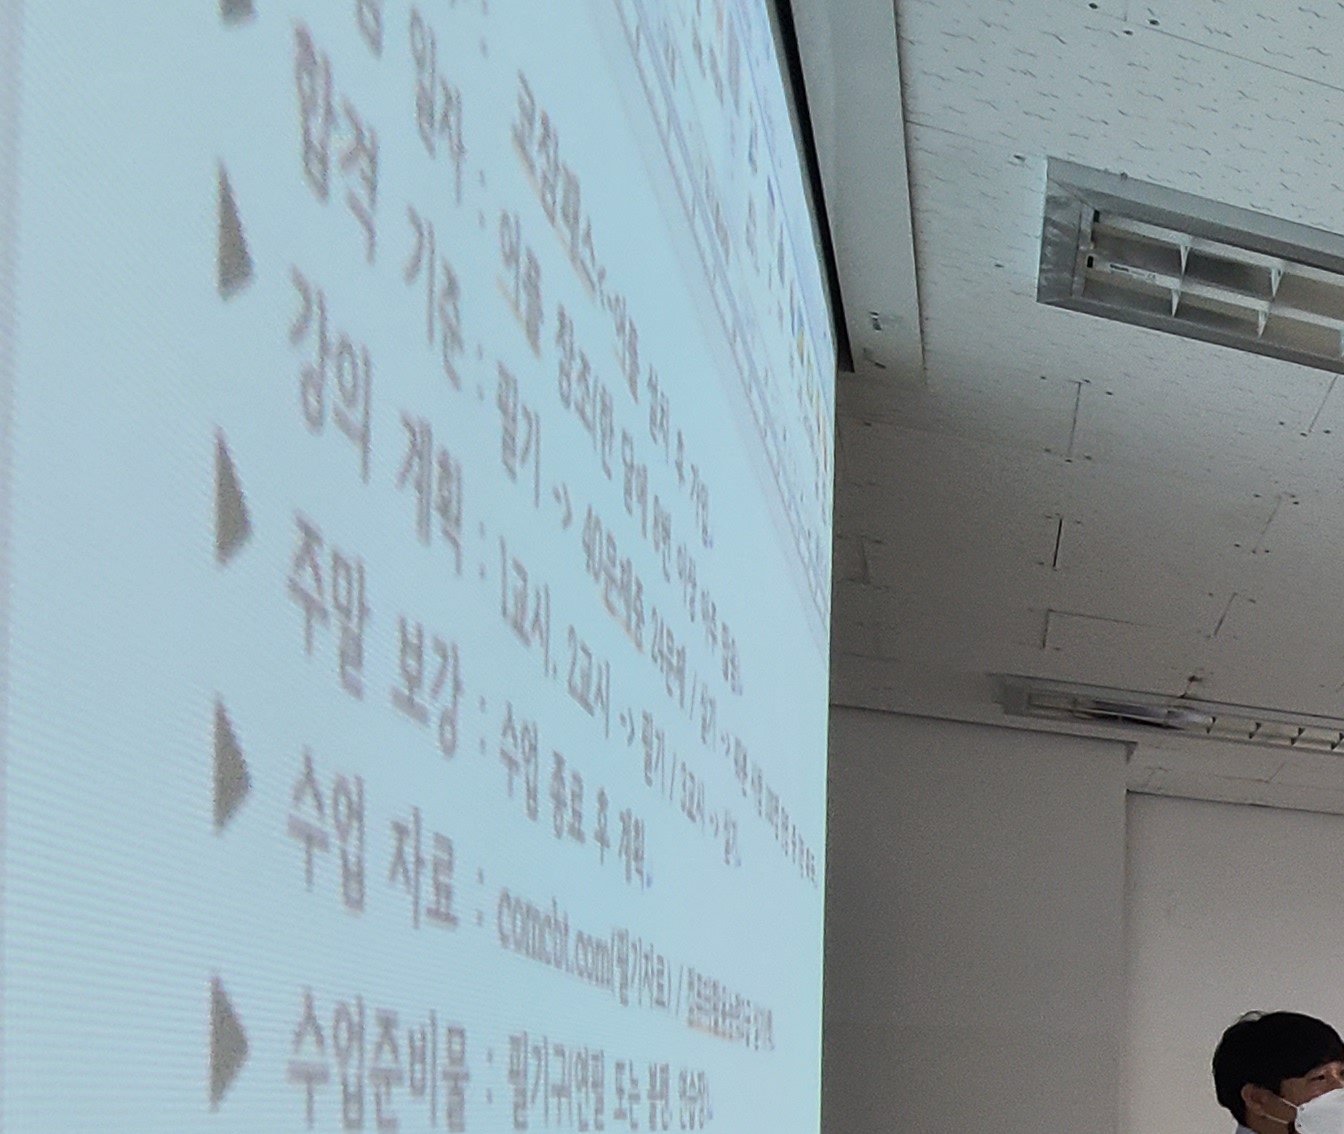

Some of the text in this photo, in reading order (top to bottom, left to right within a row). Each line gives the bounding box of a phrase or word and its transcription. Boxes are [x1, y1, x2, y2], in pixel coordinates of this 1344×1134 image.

[407, 6, 467, 207] 일자
[294, 25, 381, 264] 합격
[404, 205, 465, 393] 기준
[496, 359, 541, 509] 필기
[287, 268, 374, 485] 강의
[399, 414, 463, 578] 계획
[567, 623, 611, 740] 2교시
[641, 709, 665, 796] 필기
[287, 514, 372, 702] 주말
[392, 616, 463, 760] 보강
[499, 700, 540, 824] 수업
[550, 749, 586, 846] 종료
[593, 787, 611, 866] 후
[617, 806, 646, 891] 계획
[288, 752, 367, 913] 수업
[389, 807, 460, 933] 자료
[507, 1030, 606, 1134] 필기구(연필
[613, 1058, 642, 1133] 또는
